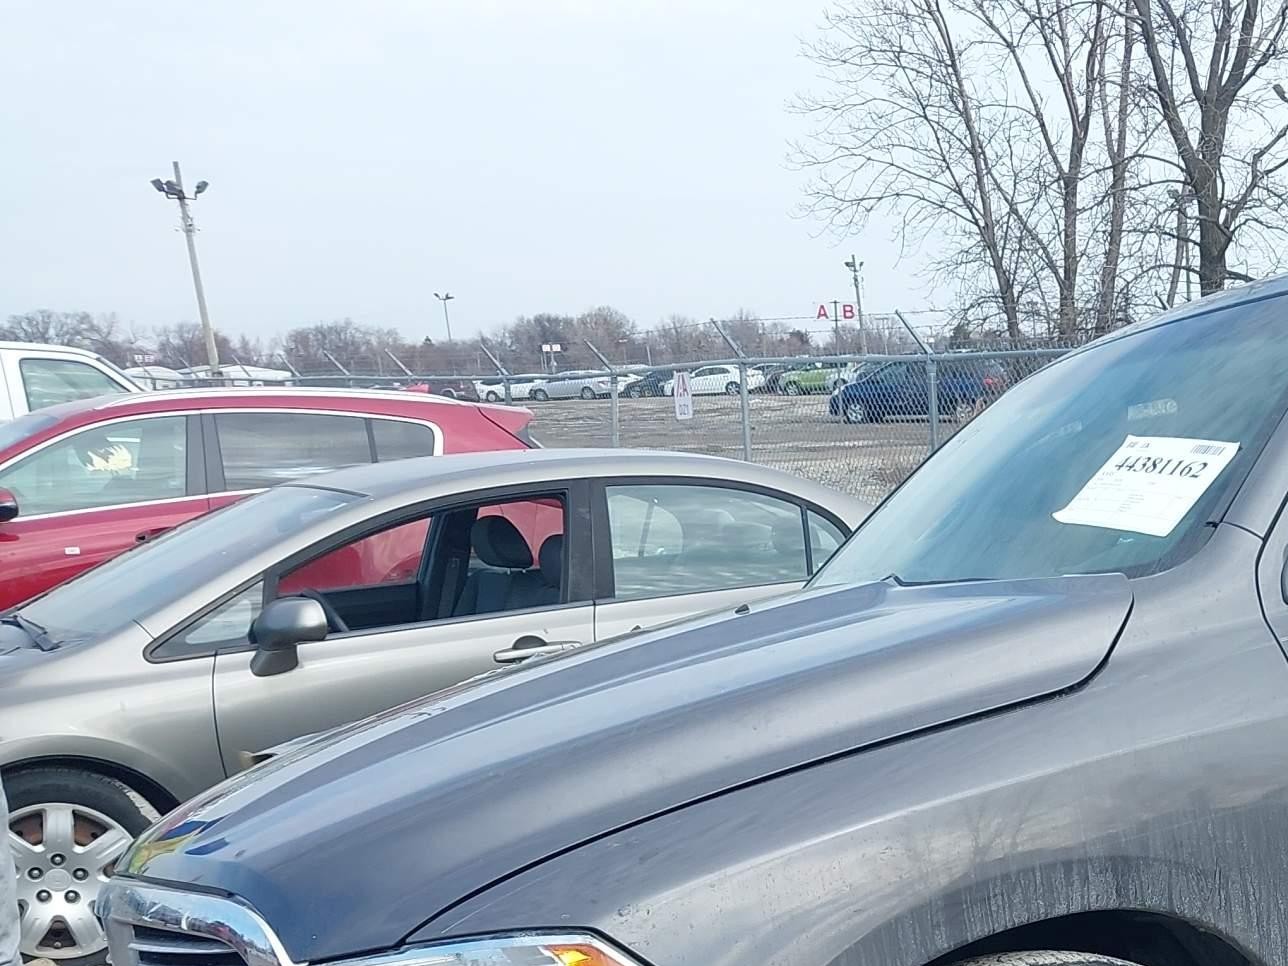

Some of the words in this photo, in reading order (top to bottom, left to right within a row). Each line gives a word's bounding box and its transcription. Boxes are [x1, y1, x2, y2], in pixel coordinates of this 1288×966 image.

[816, 304, 829, 319] A
[842, 304, 855, 319] B
[1115, 456, 1208, 478] 44381162
